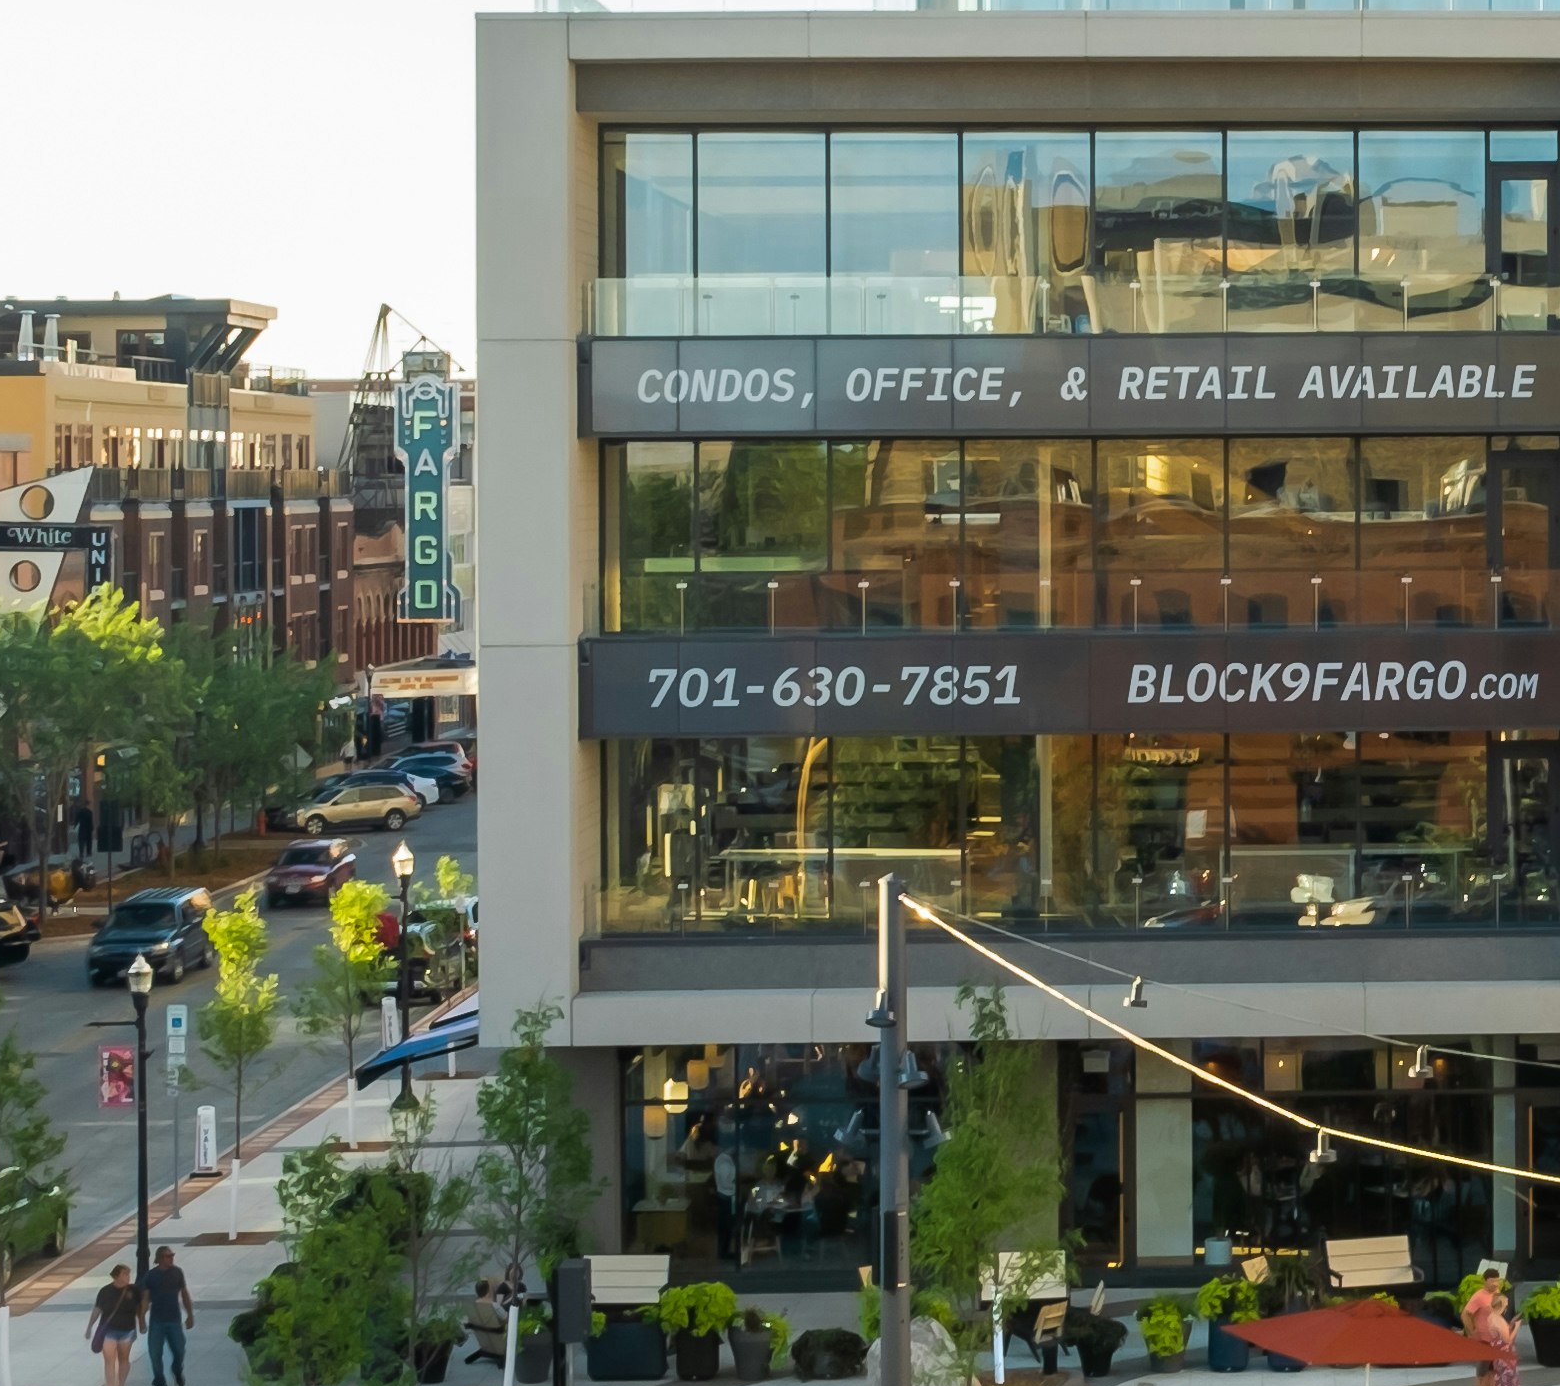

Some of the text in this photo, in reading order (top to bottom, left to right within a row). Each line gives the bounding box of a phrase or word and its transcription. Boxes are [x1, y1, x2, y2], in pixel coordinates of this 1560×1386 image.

[637, 364, 1537, 409] CONDOS, OFFICE, & RETAIL AVAILABLE
[413, 411, 438, 609] FARGO
[7, 527, 72, 546] White
[648, 665, 1021, 708] 701-630-7851
[1127, 660, 1539, 703] BLOCK9FARGO.COM
